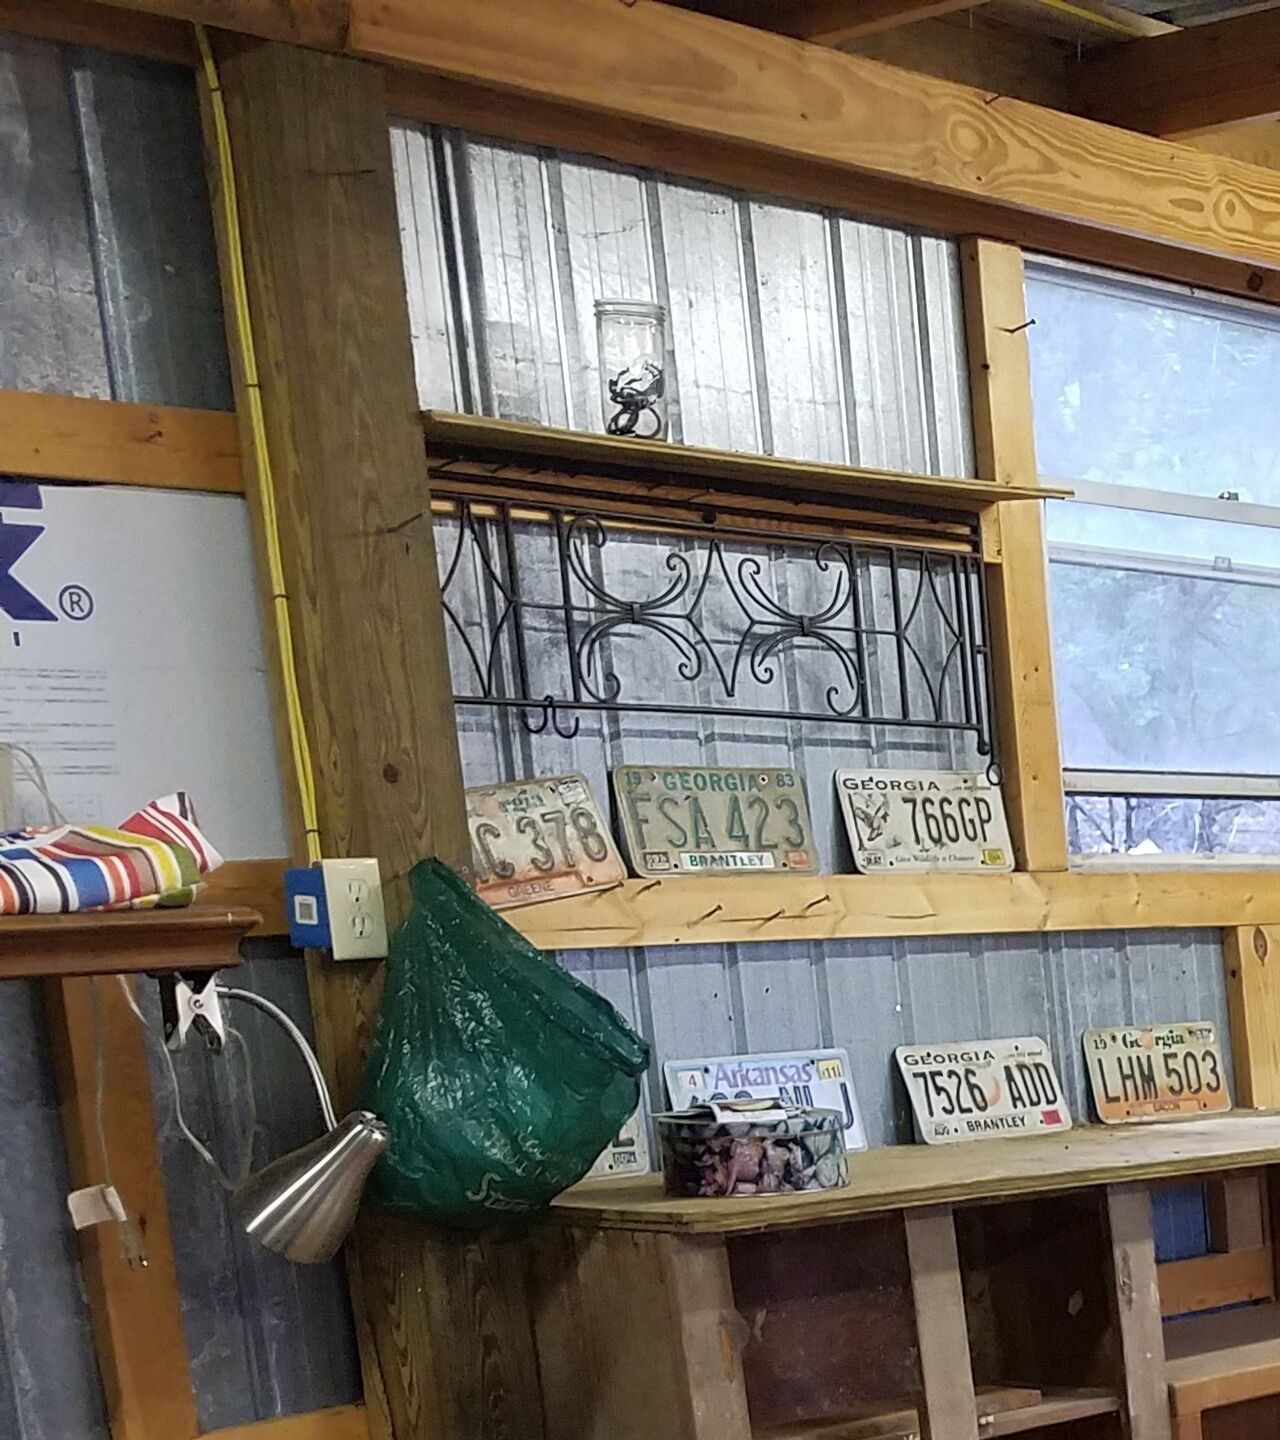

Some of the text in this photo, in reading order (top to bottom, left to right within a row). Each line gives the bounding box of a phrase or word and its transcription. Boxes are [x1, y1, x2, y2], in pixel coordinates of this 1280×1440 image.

[662, 772, 762, 792] GEORGIA
[775, 773, 795, 788] 83
[843, 778, 941, 792] GEORGIA
[628, 793, 805, 850] FSA 423
[902, 796, 993, 846] 766GP
[516, 806, 608, 872] 378
[689, 854, 767, 868] BRANTLEY
[507, 883, 556, 898] GREENE
[903, 1050, 996, 1066] GEORGIA
[688, 1074, 698, 1087] 4
[714, 1061, 814, 1089] Arkansas
[1097, 1049, 1221, 1103] LHM 503
[911, 1062, 1058, 1118] 7526 ADD
[966, 1115, 1027, 1132] BRANTLEY
